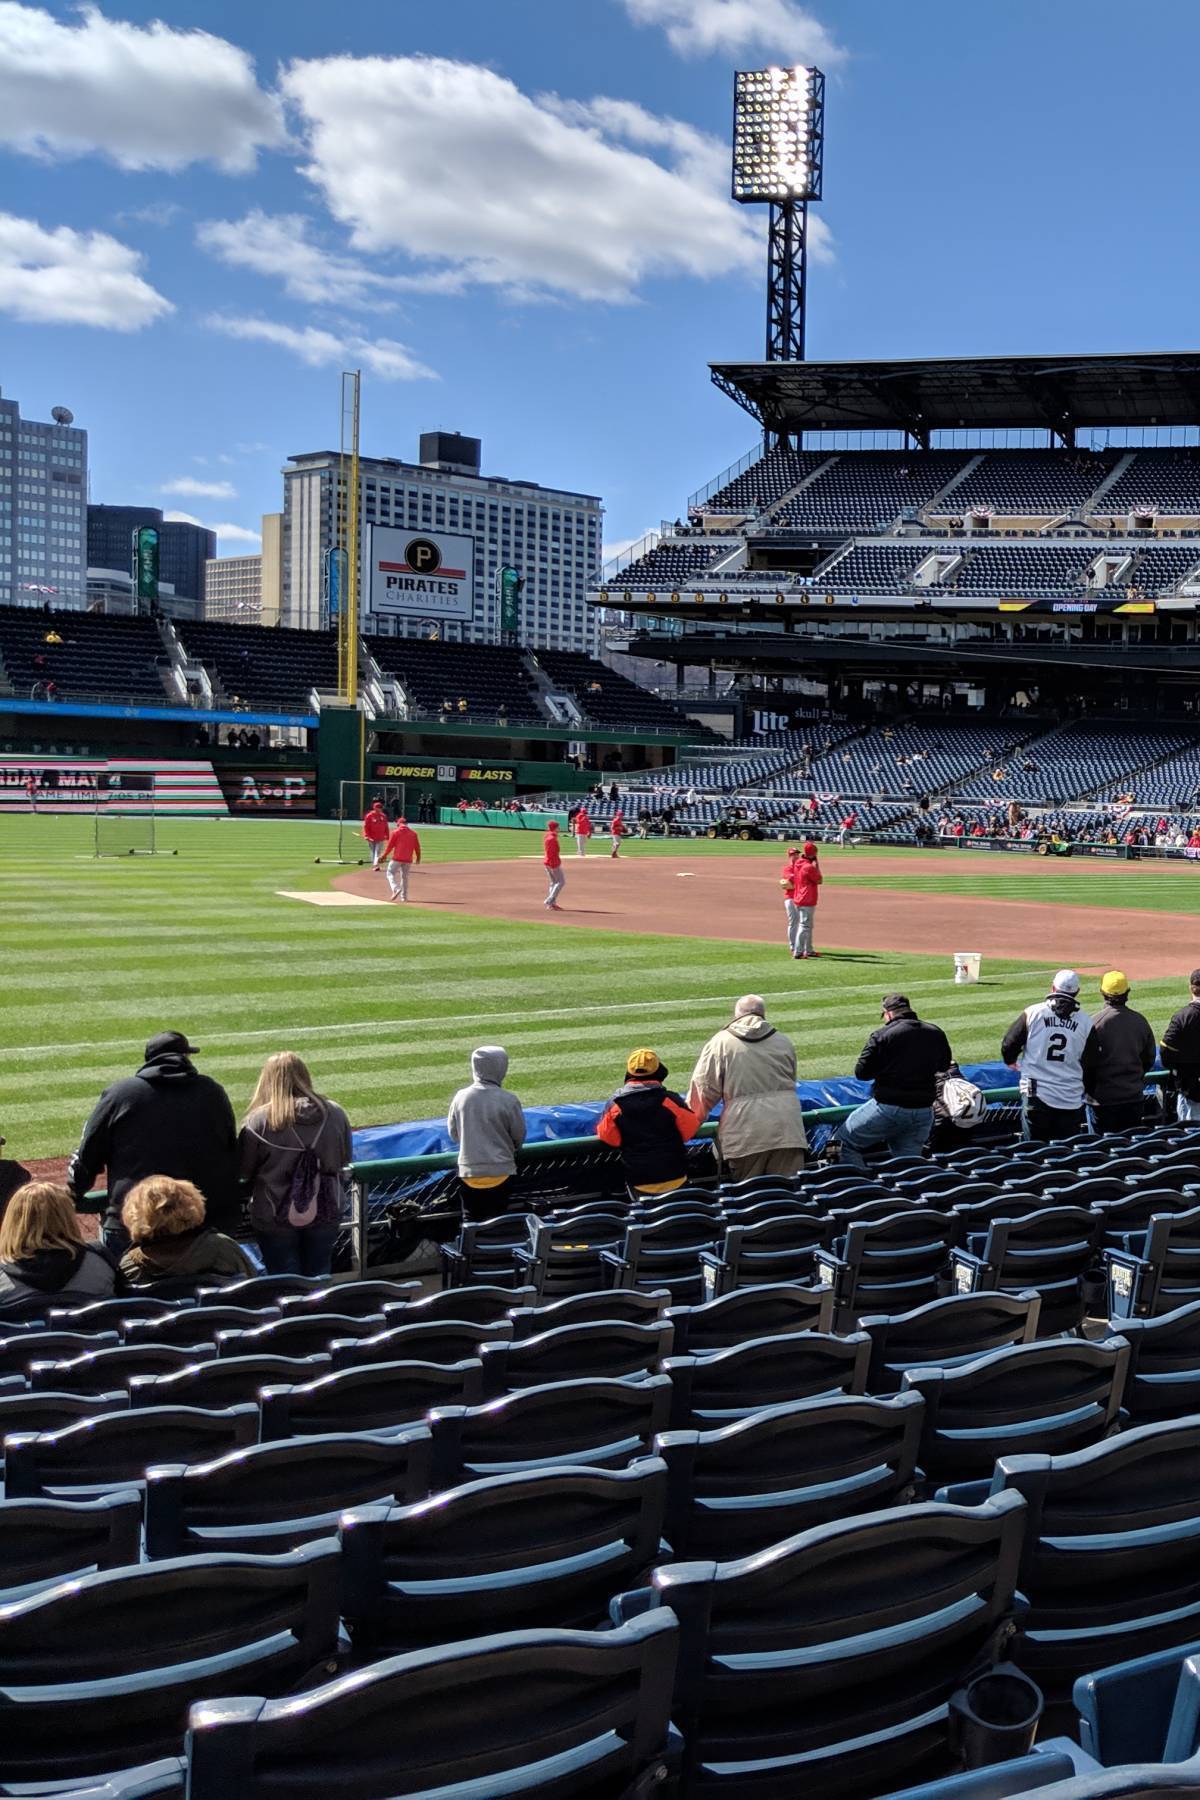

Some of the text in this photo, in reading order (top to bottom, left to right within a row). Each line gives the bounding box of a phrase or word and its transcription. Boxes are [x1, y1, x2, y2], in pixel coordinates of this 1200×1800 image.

[416, 546, 432, 567] P
[386, 576, 458, 595] PIRATES
[386, 590, 458, 606] CHARITIES
[1053, 603, 1098, 612] OPENING DAY
[795, 708, 848, 720] skull bar
[753, 710, 789, 736] Lite
[385, 766, 435, 778] BOWSER
[469, 770, 512, 781] BLASTS
[1044, 1016, 1079, 1033] WILSON
[1047, 1033, 1067, 1062] 2
